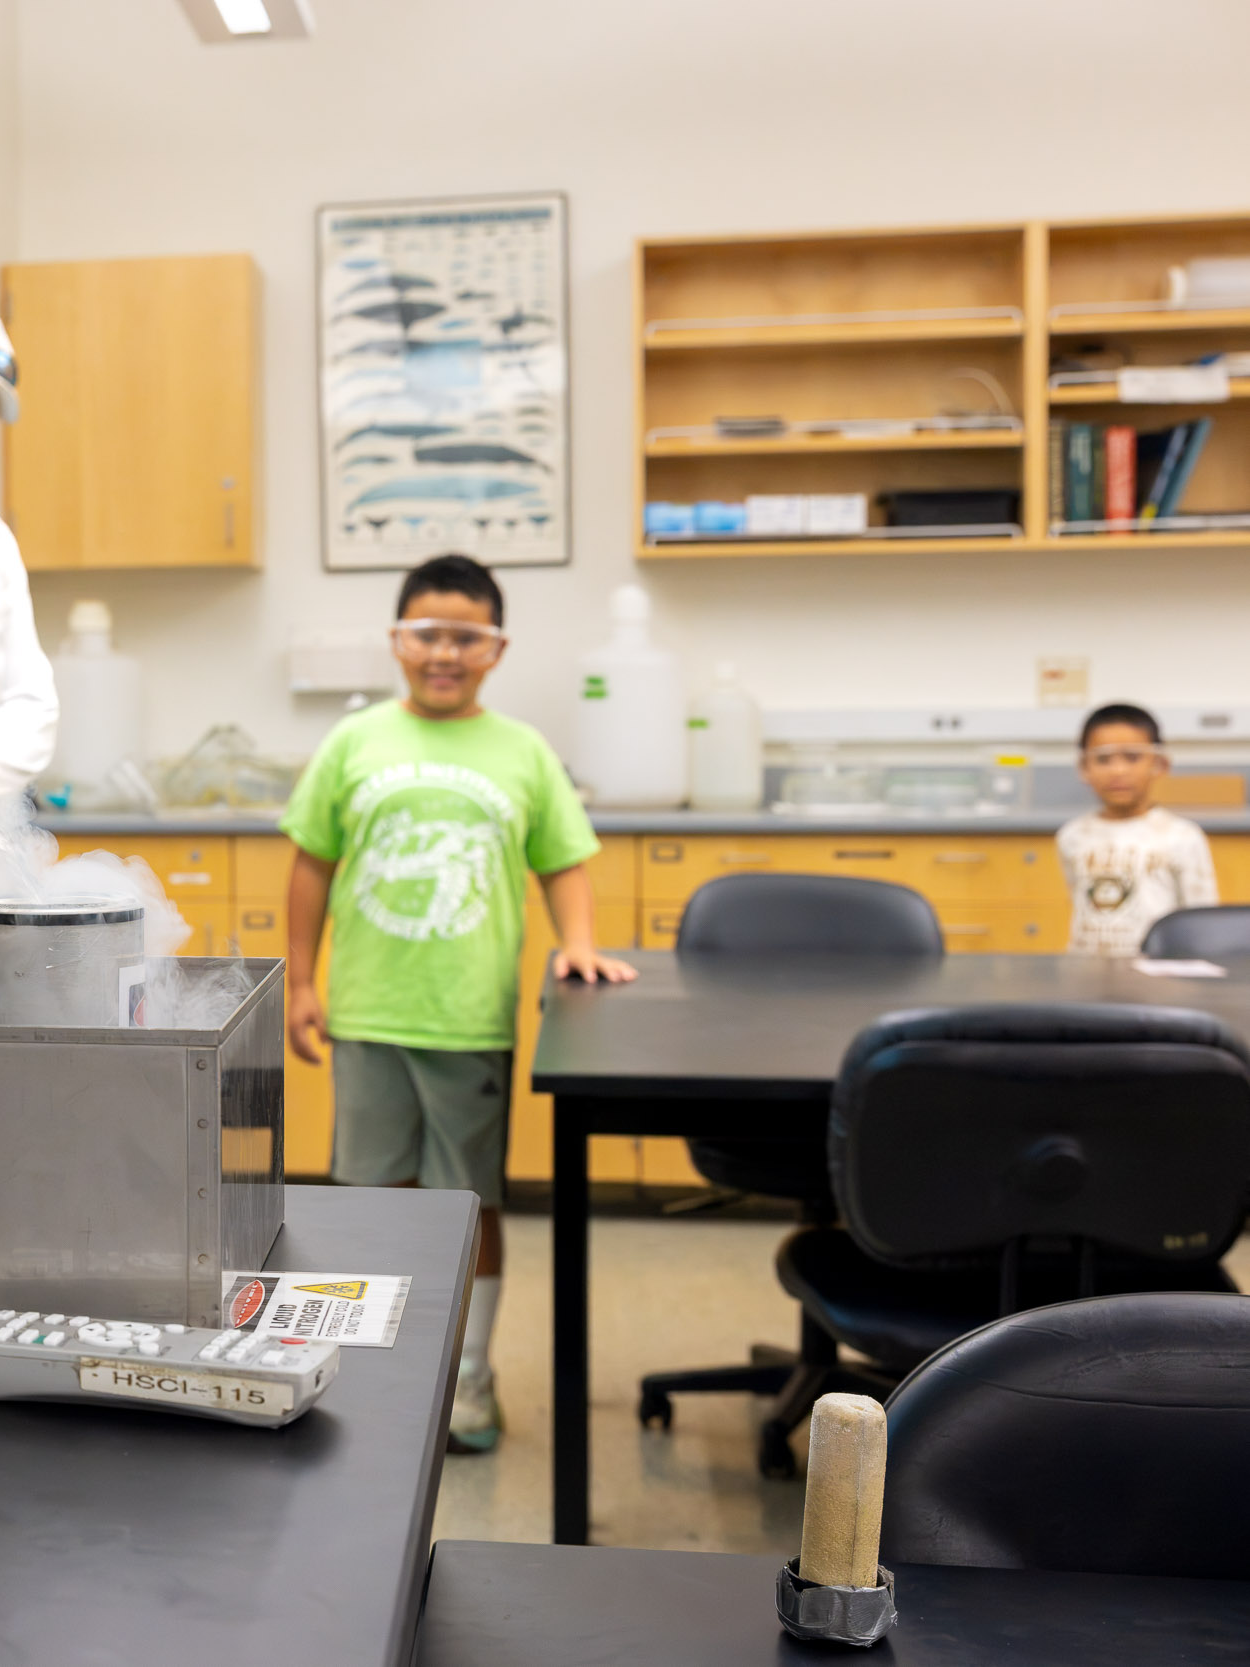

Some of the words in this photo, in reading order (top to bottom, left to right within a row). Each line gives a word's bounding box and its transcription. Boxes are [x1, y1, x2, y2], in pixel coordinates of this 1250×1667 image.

[269, 1304, 297, 1328] LIQUID
[292, 1299, 325, 1336] NITROGEN
[113, 1371, 266, 1405] HSCI-115
